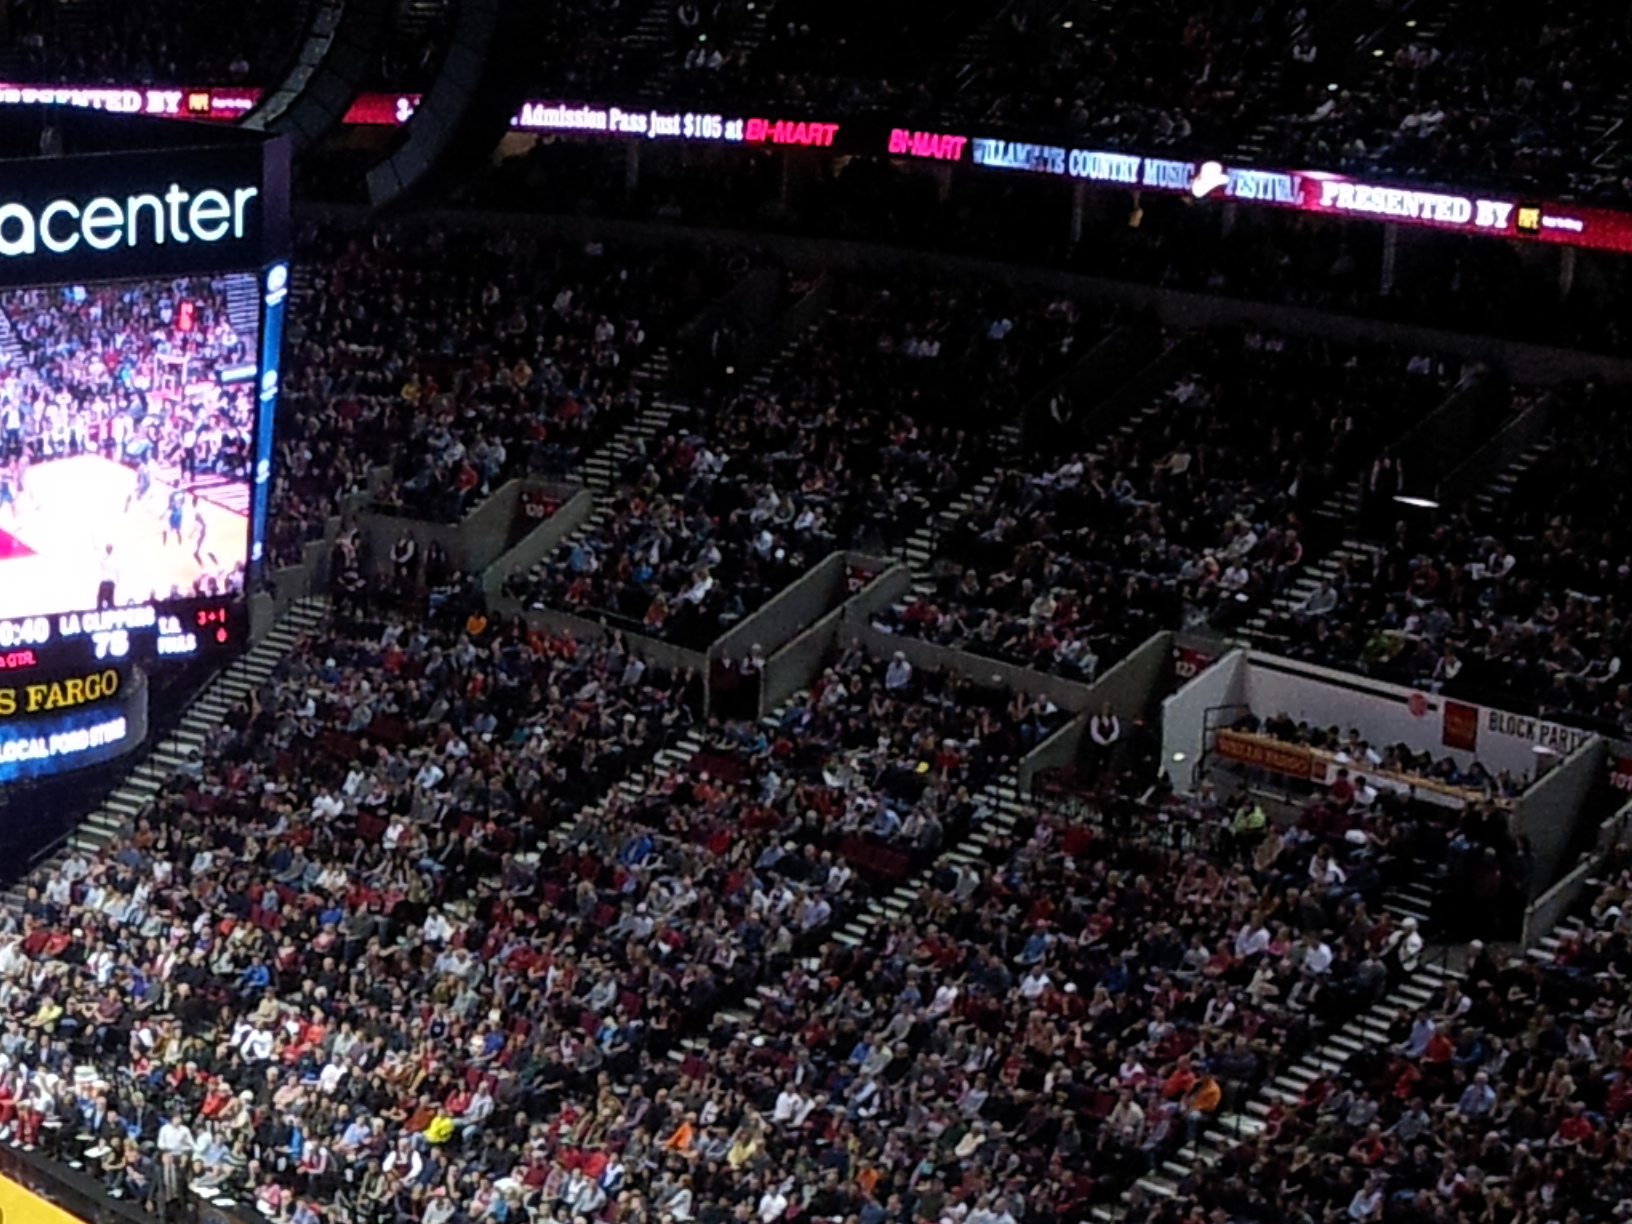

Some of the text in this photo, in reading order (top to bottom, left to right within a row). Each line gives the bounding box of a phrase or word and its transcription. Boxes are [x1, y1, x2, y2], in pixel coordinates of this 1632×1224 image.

[146, 91, 182, 113] BY
[520, 102, 840, 147] Admission Pass just $105 at BI-MART
[888, 128, 967, 162] BI-MART
[1069, 149, 1142, 183] COUNTRY
[1143, 158, 1195, 189] MUSIC
[1225, 168, 1304, 204] FESTIVAL
[1320, 180, 1471, 224] PRESENTED
[1475, 200, 1513, 229] BY
[60, 615, 80, 635] LA
[26, 669, 118, 712] FARGO
[1489, 711, 1535, 740] BLOCK
